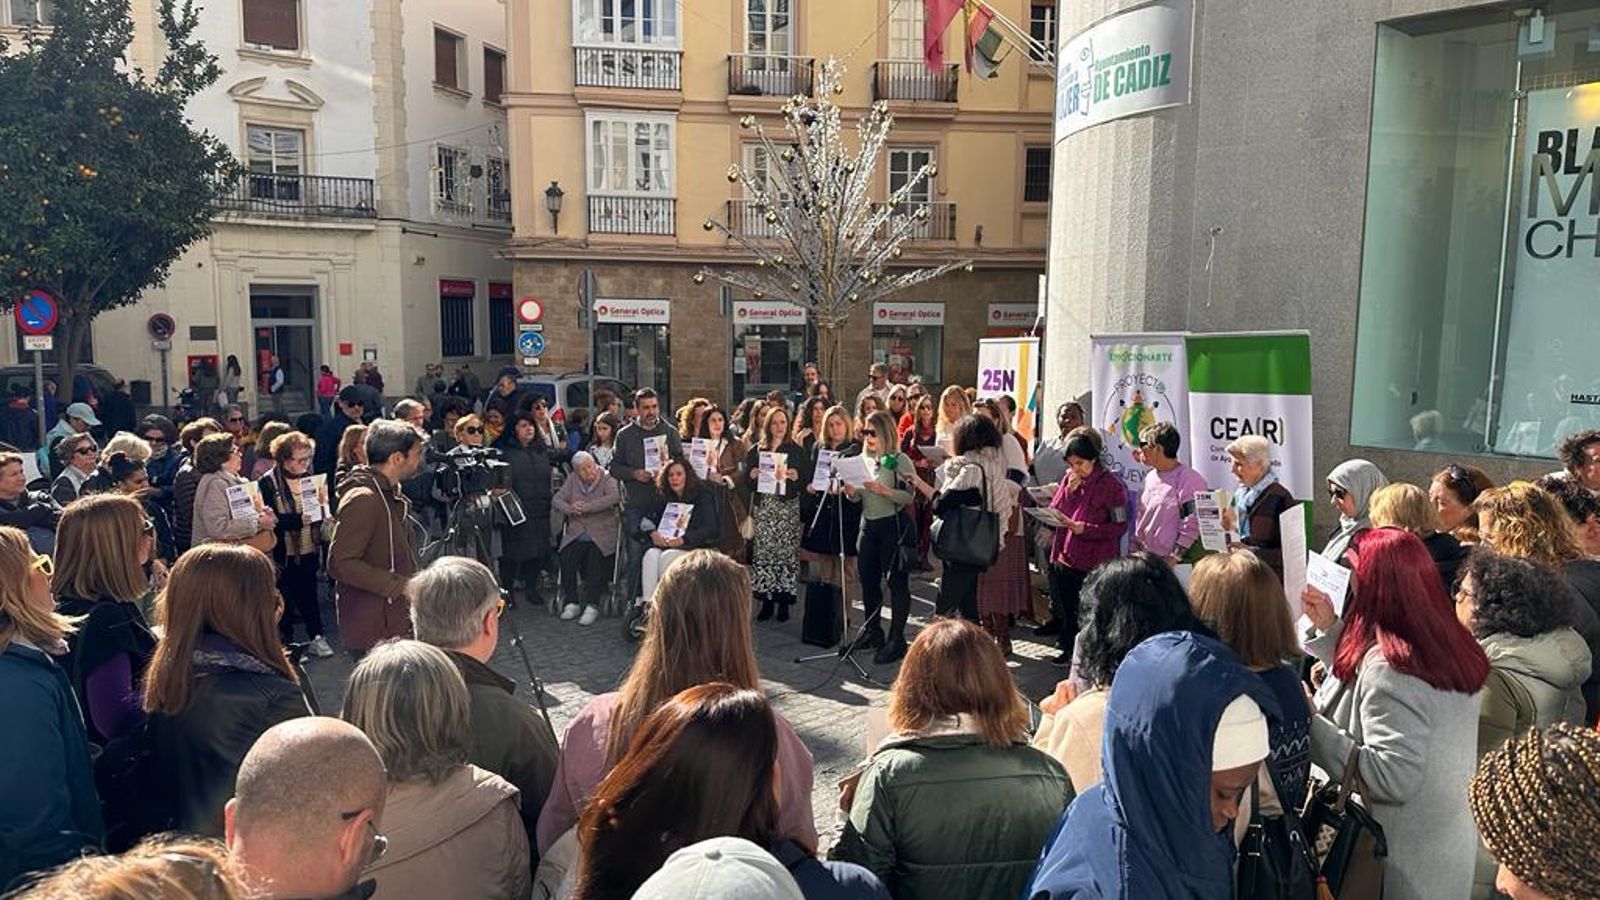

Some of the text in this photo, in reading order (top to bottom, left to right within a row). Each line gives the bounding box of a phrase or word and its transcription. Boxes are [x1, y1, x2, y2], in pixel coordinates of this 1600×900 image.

[1093, 71, 1111, 104] DE
[982, 369, 1015, 392] 25N
[1210, 417, 1284, 446] CEA(R)
